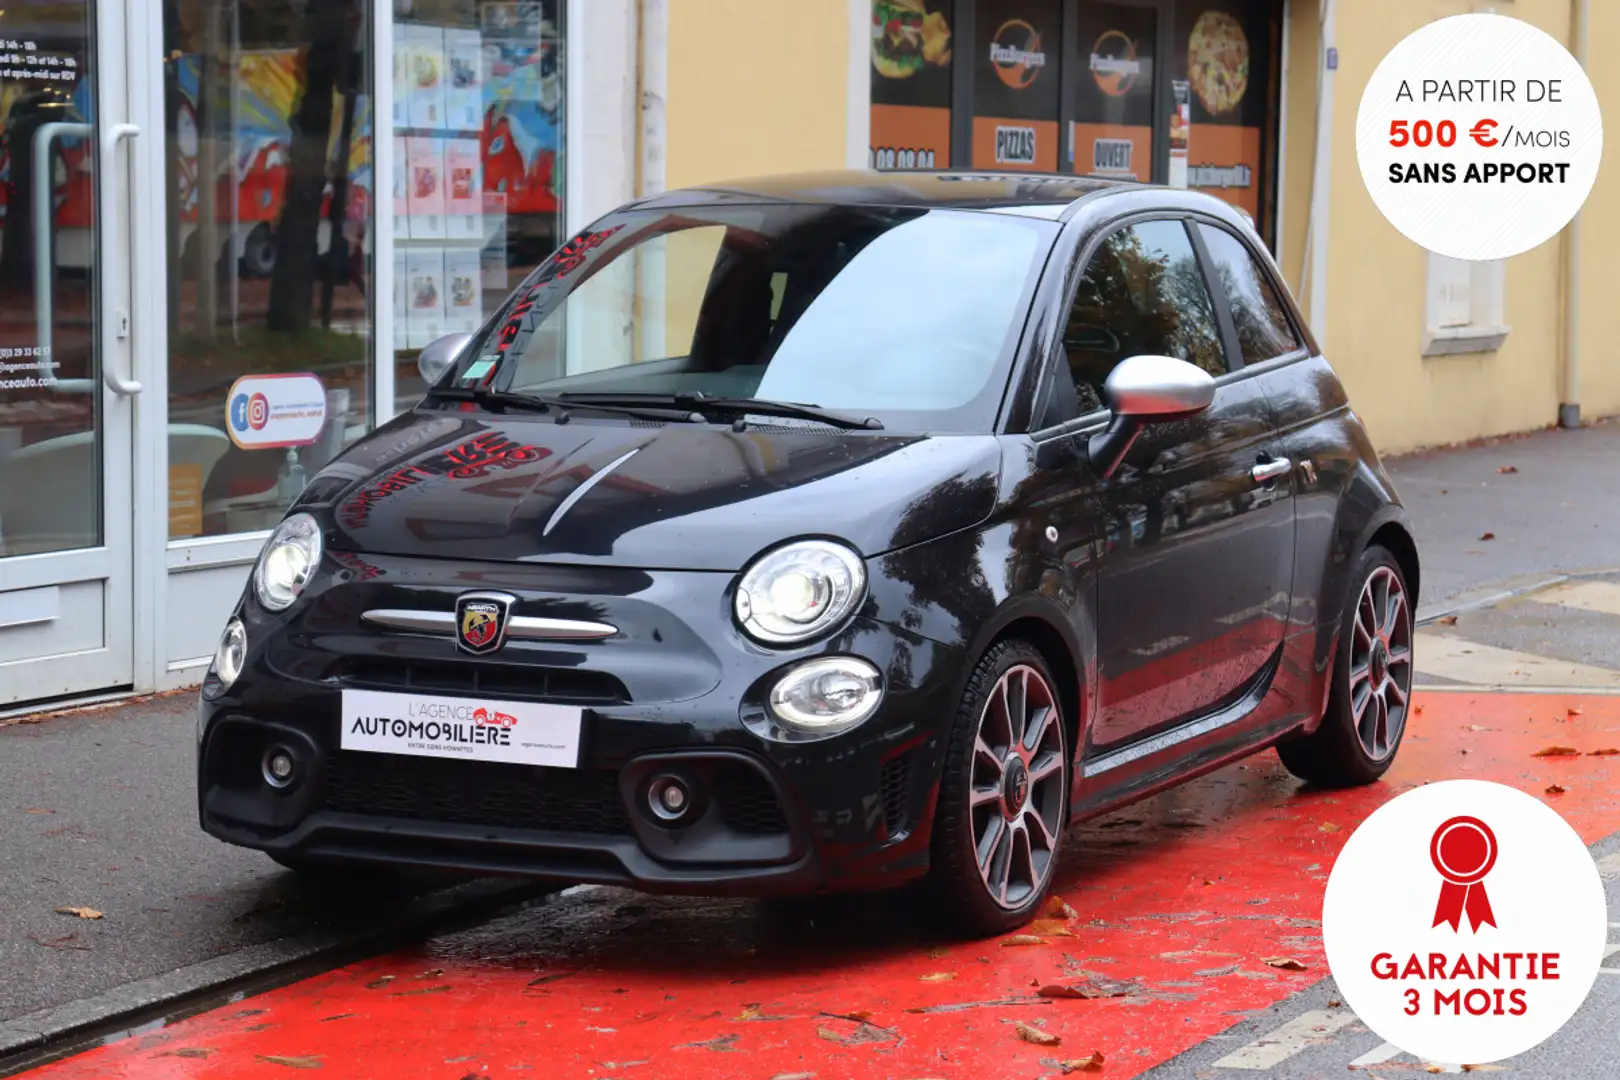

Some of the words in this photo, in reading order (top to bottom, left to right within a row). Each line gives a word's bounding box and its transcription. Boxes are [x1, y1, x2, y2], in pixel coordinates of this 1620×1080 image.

[61, 70, 76, 80] RDV
[997, 129, 1035, 161] PIZZAS
[1094, 140, 1132, 169] OUVERT
[14, 347, 22, 357] 29
[24, 347, 31, 357] 33
[408, 702, 474, 721] L'AGENCE
